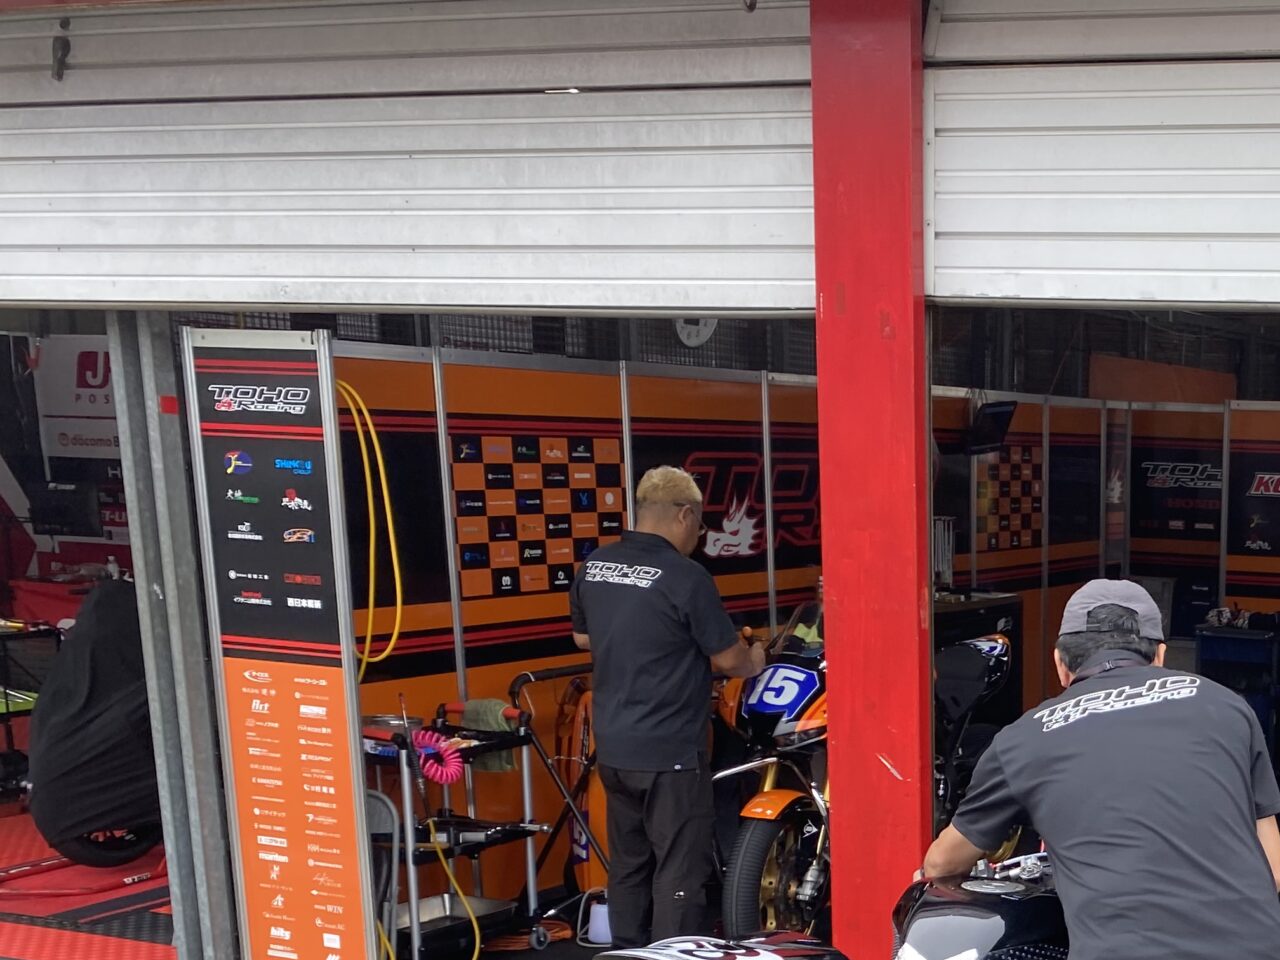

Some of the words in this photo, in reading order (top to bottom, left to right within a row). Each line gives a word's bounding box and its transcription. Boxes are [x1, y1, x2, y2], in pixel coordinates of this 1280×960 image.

[75, 394, 110, 404] POS
[208, 385, 310, 403] TOHO
[236, 399, 306, 415] Racing
[1141, 462, 1224, 479] TOH
[586, 561, 662, 579] TOHO
[599, 573, 652, 588] Racing
[747, 667, 806, 705] 15
[1033, 676, 1200, 722] TOHO
